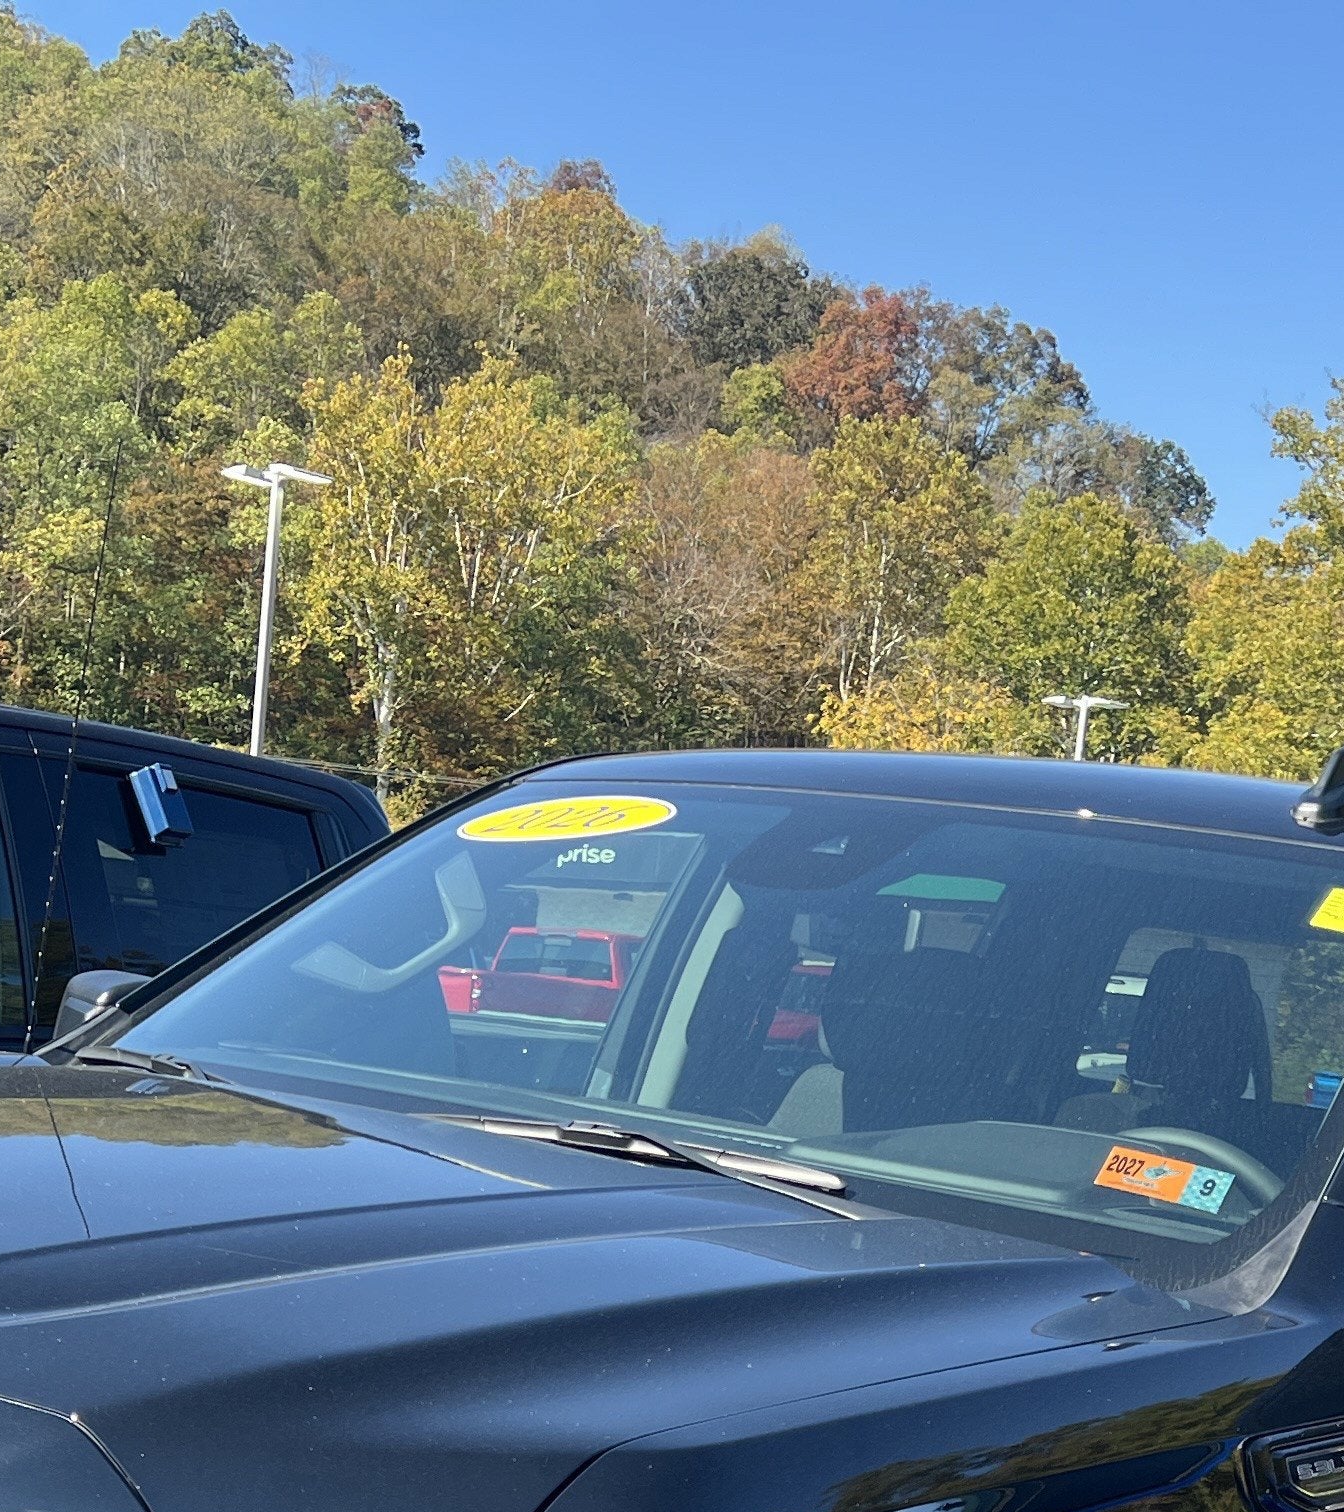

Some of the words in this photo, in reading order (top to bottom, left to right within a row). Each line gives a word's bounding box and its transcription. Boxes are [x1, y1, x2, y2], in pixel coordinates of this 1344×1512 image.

[479, 804, 649, 834] 2026
[1106, 1154, 1145, 1177] 2027
[1199, 1178, 1217, 1197] 9
